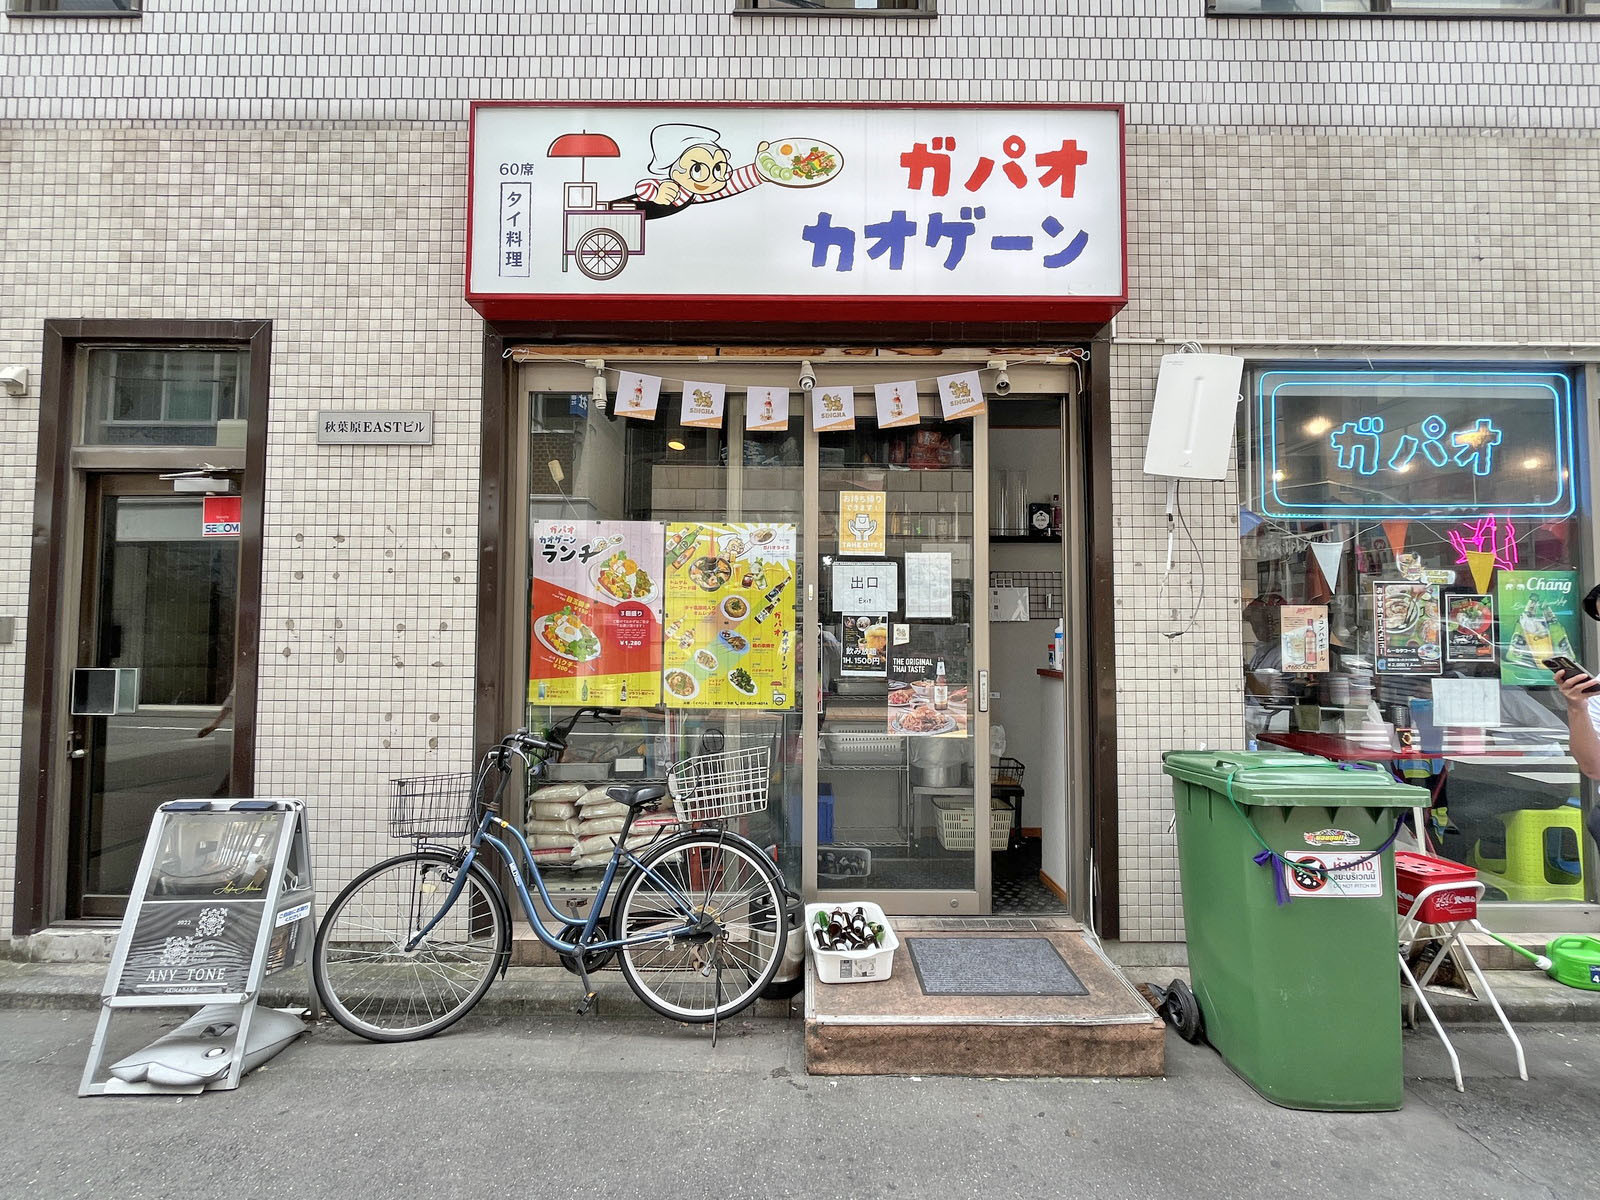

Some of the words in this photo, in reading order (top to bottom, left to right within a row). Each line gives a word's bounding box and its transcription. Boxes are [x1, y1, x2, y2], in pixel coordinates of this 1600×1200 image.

[499, 162, 534, 176] 60席
[900, 135, 1087, 198] ガパオ
[505, 190, 523, 268] タイ料理
[802, 206, 1088, 272] カオゲーン
[949, 397, 975, 407] SINGHA
[689, 407, 714, 415] SINGHA
[820, 411, 847, 419] SINGHA
[325, 420, 425, 433] 秋葉原EASTビル
[1330, 415, 1502, 476] ガパオ
[205, 523, 239, 533] SECOM
[549, 525, 574, 535] ガパオ
[539, 535, 577, 544] カオゲーン
[542, 544, 597, 564] ランチ
[850, 576, 879, 589] 出口
[1526, 577, 1572, 594] Chang
[845, 646, 877, 656] 飲み放題
[893, 657, 904, 666] THE
[905, 657, 933, 666] ORIGINAL
[893, 665, 906, 673] THAI
[907, 665, 926, 674] TASTE
[145, 969, 178, 982] ANY
[187, 967, 226, 981] TONE
